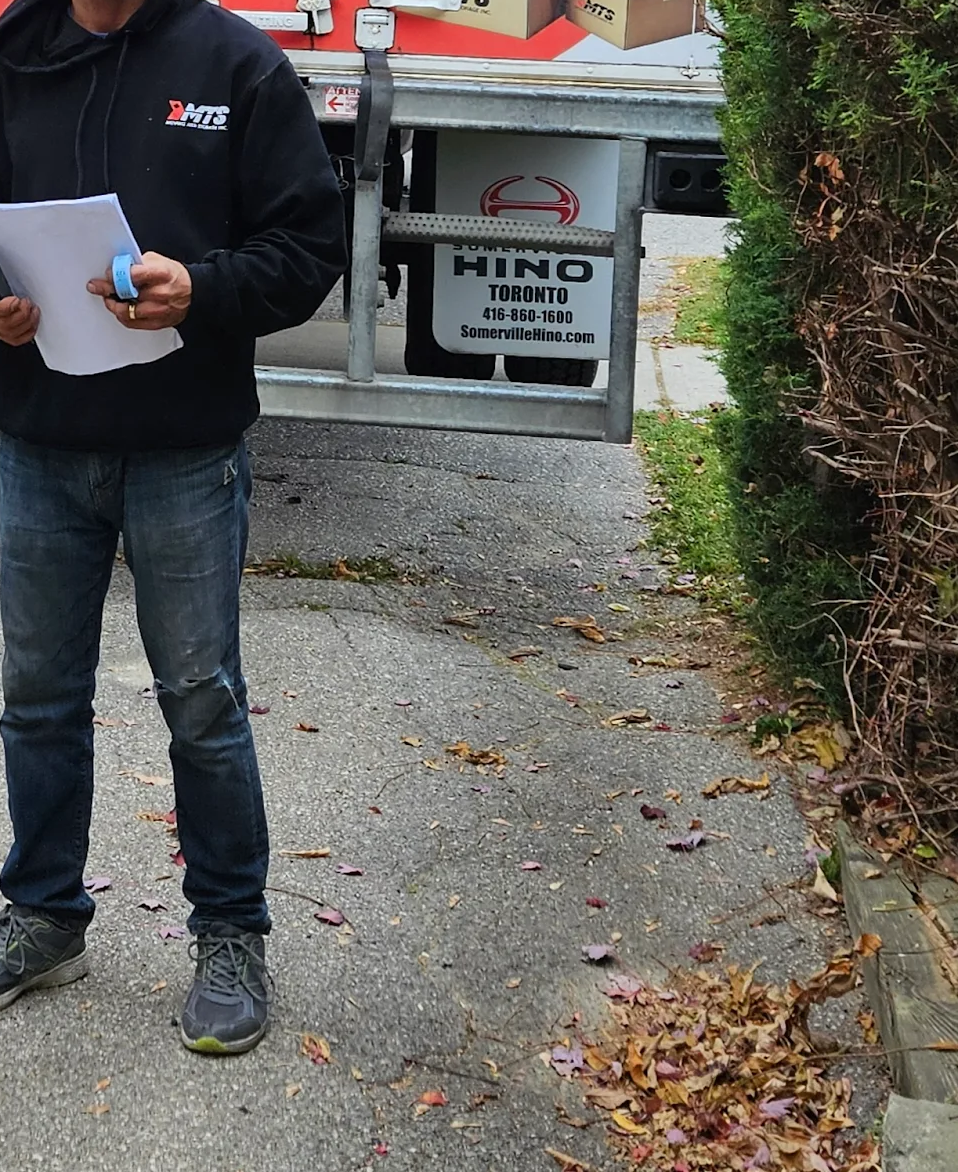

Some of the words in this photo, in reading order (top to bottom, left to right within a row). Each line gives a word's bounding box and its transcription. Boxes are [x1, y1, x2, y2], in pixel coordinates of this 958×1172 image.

[583, 0, 616, 22] MTS
[180, 102, 231, 126] MTS
[453, 254, 594, 283] HINO
[488, 284, 569, 305] TORONTO
[482, 307, 574, 324] 416-860-1600
[460, 324, 595, 344] SomervilleHino.com
